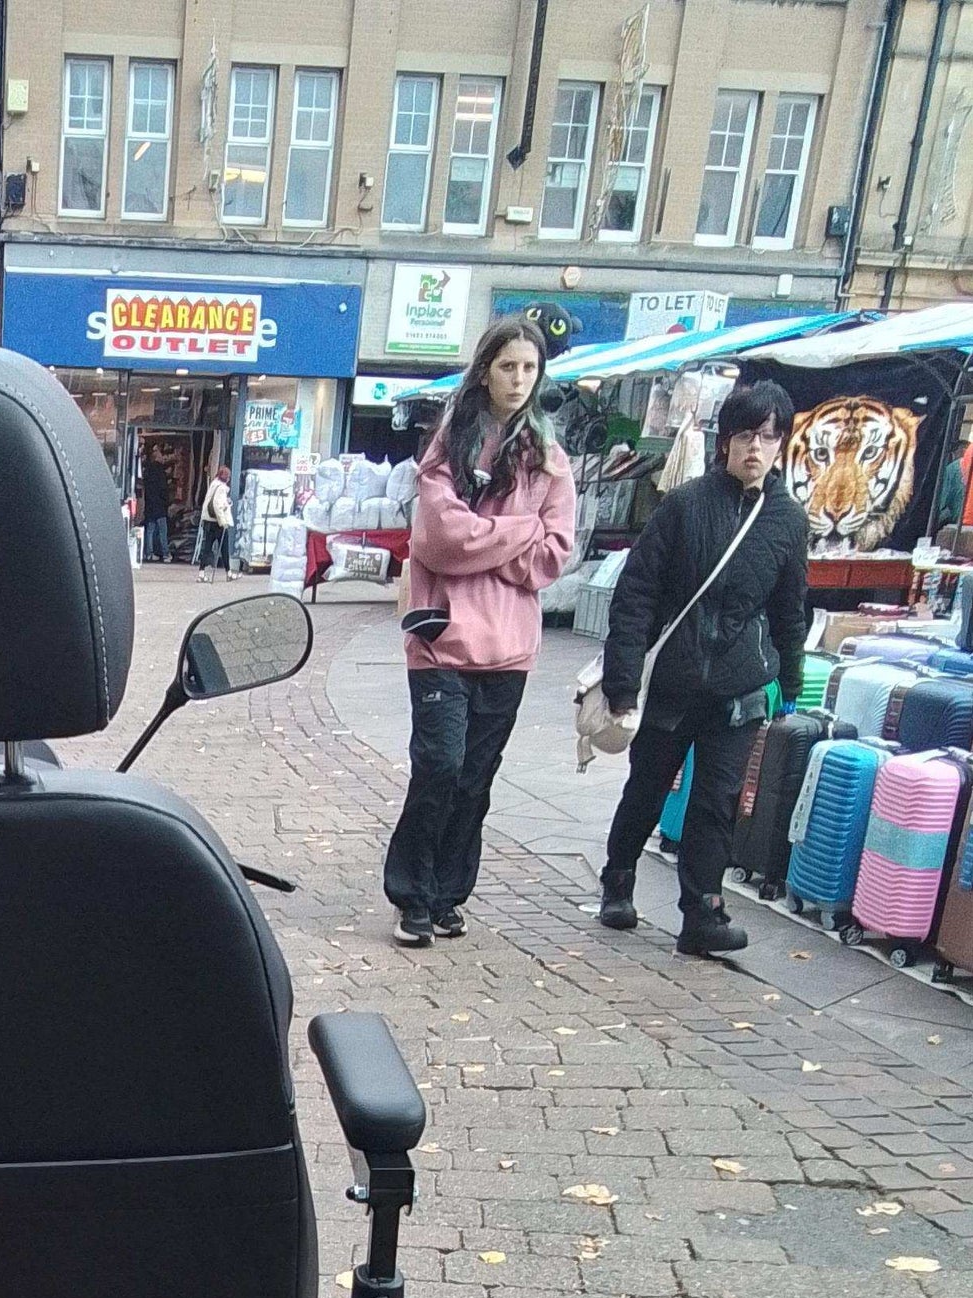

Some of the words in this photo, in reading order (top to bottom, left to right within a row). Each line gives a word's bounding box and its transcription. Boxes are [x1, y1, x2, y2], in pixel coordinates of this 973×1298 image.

[406, 302, 452, 318] Inplace
[638, 295, 659, 311] TO
[664, 294, 696, 311] LET
[112, 302, 255, 332] CLEARANCE
[111, 334, 253, 355] OUTLET
[249, 406, 279, 421] PRIME
